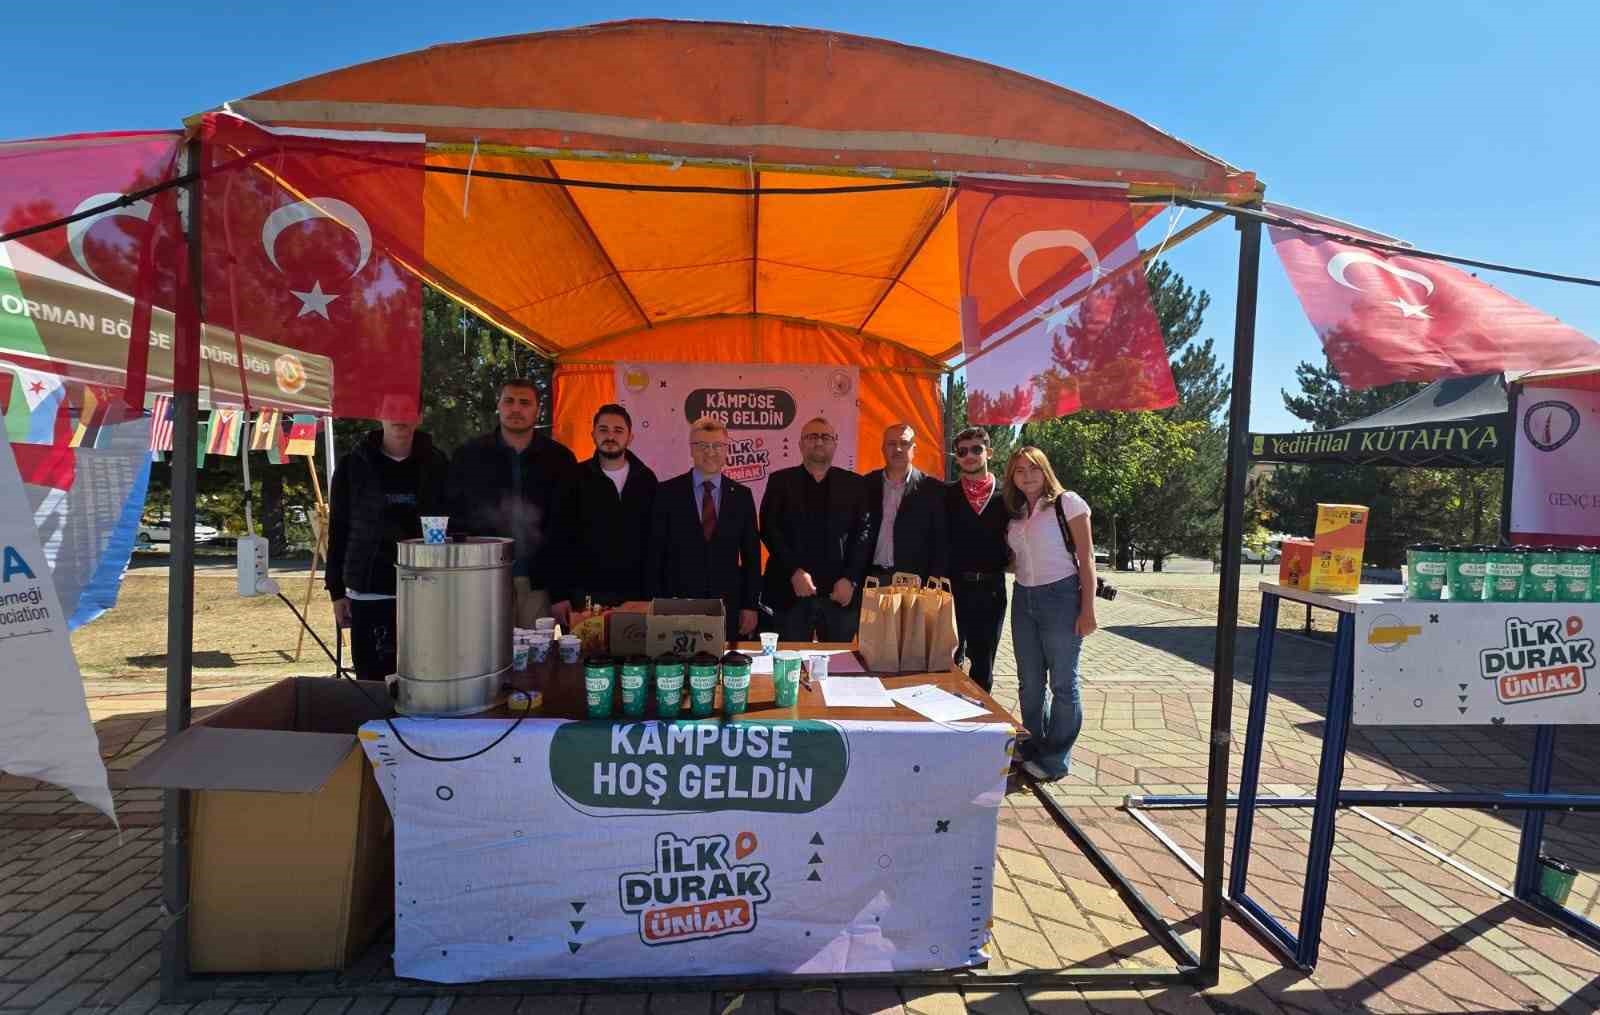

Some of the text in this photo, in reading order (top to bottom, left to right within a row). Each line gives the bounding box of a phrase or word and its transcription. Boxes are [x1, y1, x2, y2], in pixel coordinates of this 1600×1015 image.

[1, 294, 96, 333] ORMAN
[101, 316, 171, 350] BÖGE
[732, 409, 784, 426] GELDİN
[1271, 425, 1499, 456] YediHilal KÜTAHYA
[726, 452, 767, 467] URAK
[1547, 491, 1586, 511] GENÇ
[1509, 621, 1558, 649] İLK
[1484, 644, 1592, 674] DURAK
[1503, 669, 1579, 698] ÜNİAK
[592, 761, 814, 806] HOŞ GELDİN
[660, 836, 723, 874] İLK
[624, 868, 763, 906] DURAK
[650, 904, 744, 938] ÜNİAK
